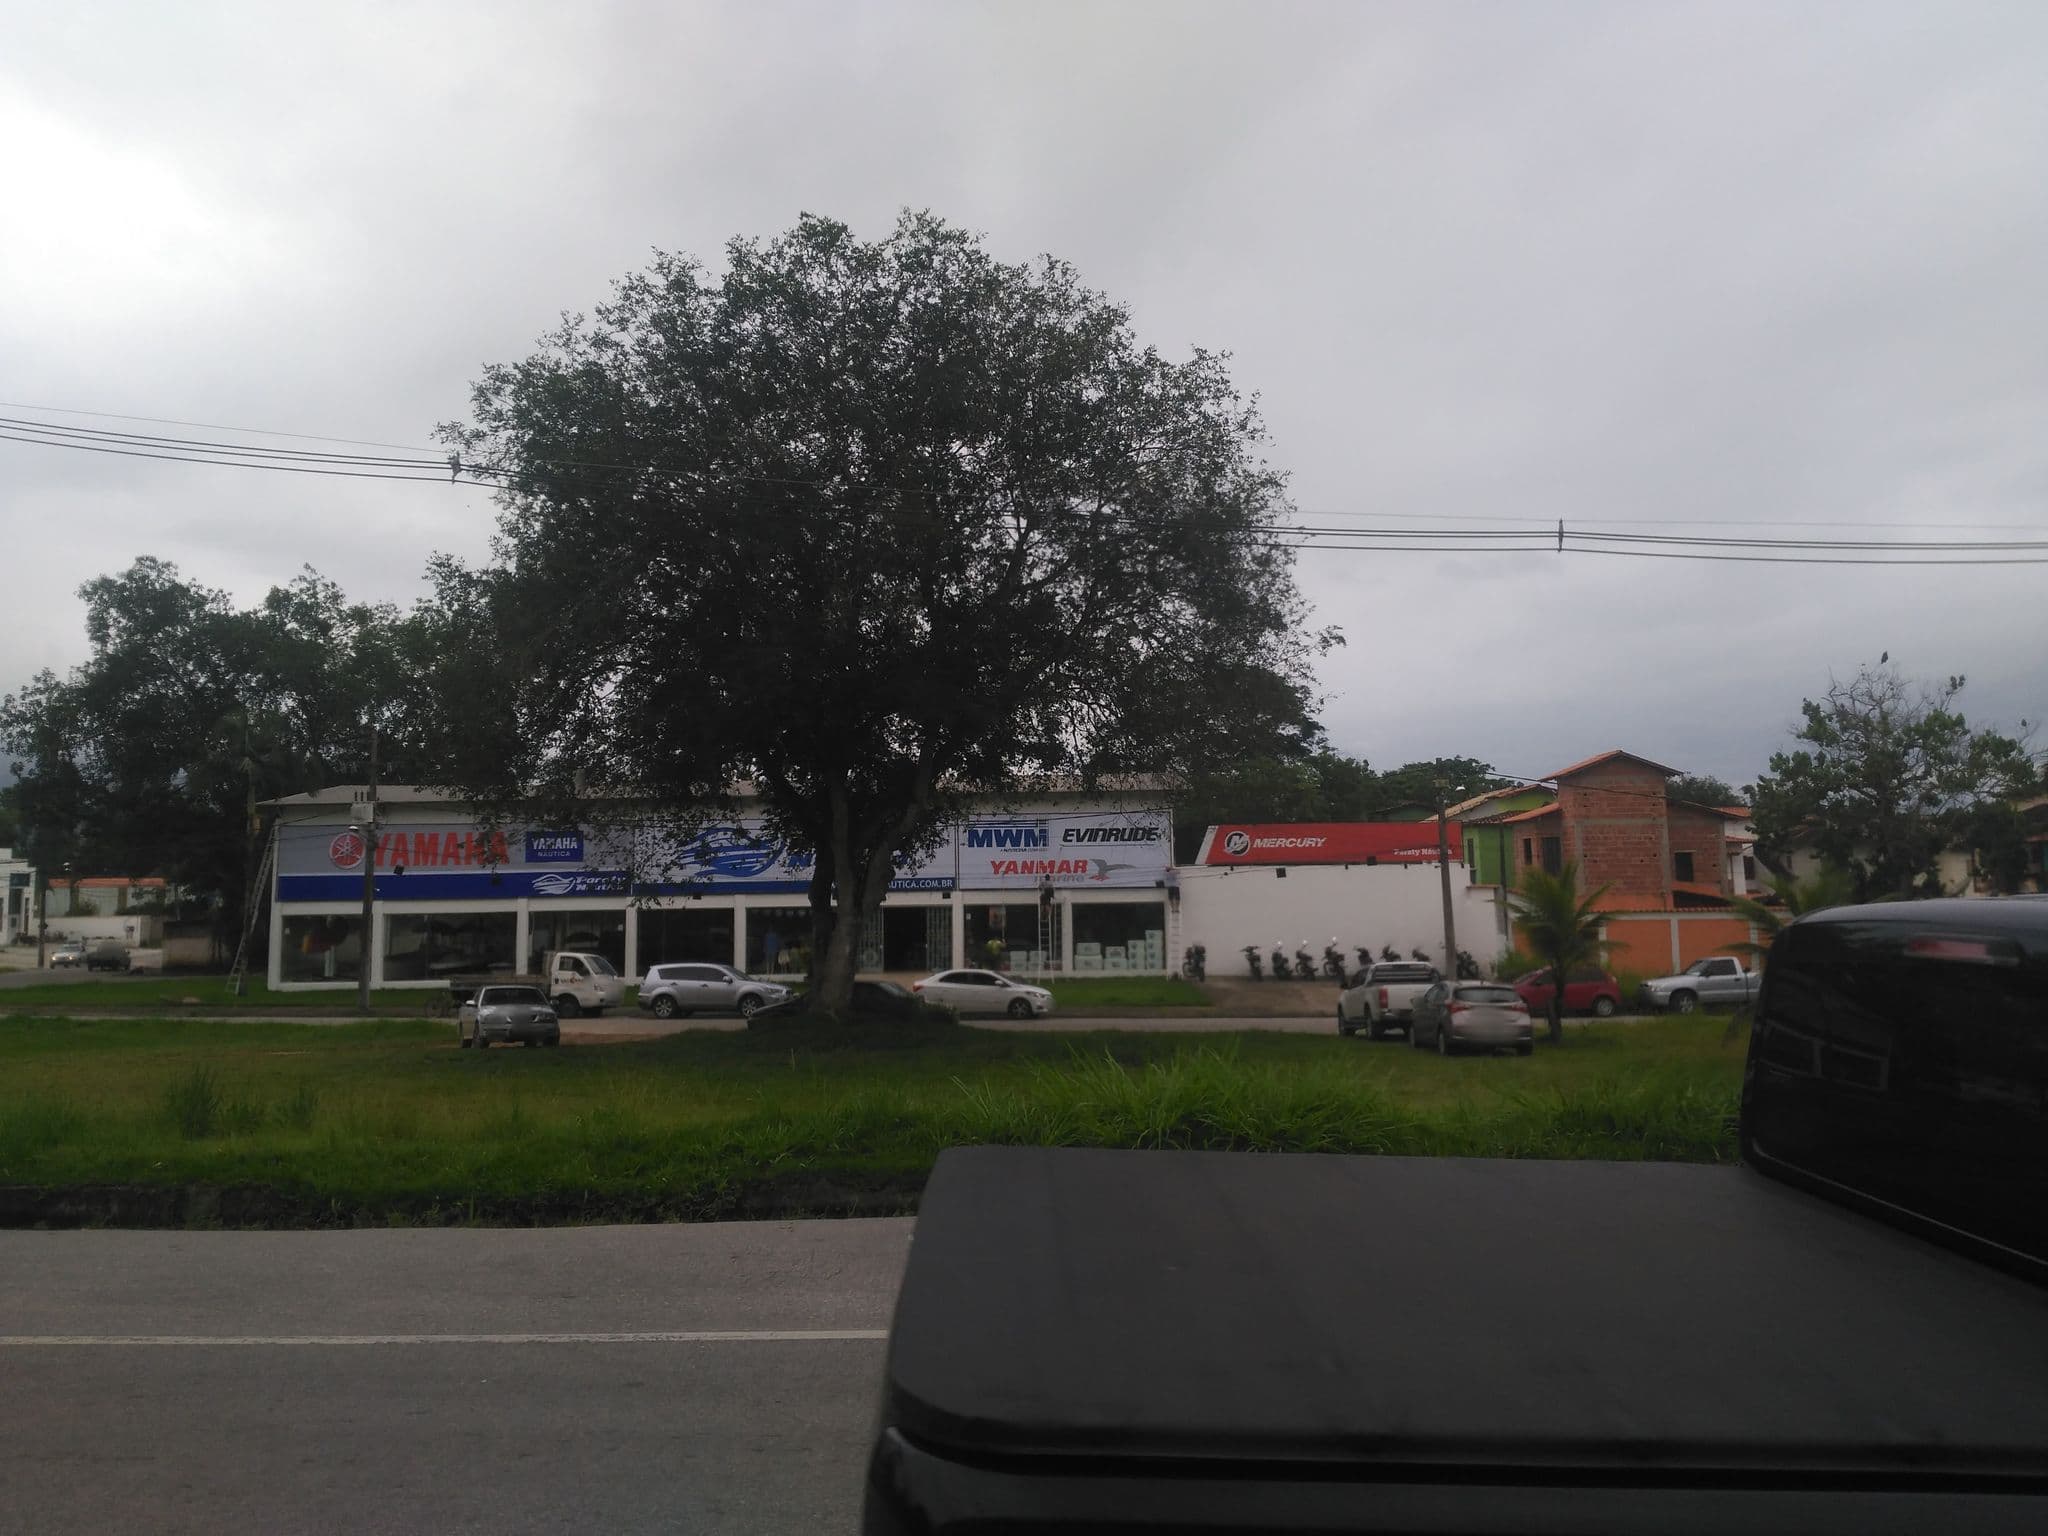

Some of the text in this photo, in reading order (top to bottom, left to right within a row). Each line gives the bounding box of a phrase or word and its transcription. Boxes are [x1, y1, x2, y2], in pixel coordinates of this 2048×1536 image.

[968, 829, 1049, 848] MWM
[1062, 828, 1159, 843] EVINRUDE
[1253, 837, 1327, 848] MERCURY
[374, 832, 510, 867] YAMAHA
[531, 837, 578, 850] YAMAHA
[990, 859, 1088, 875] YANMAR
